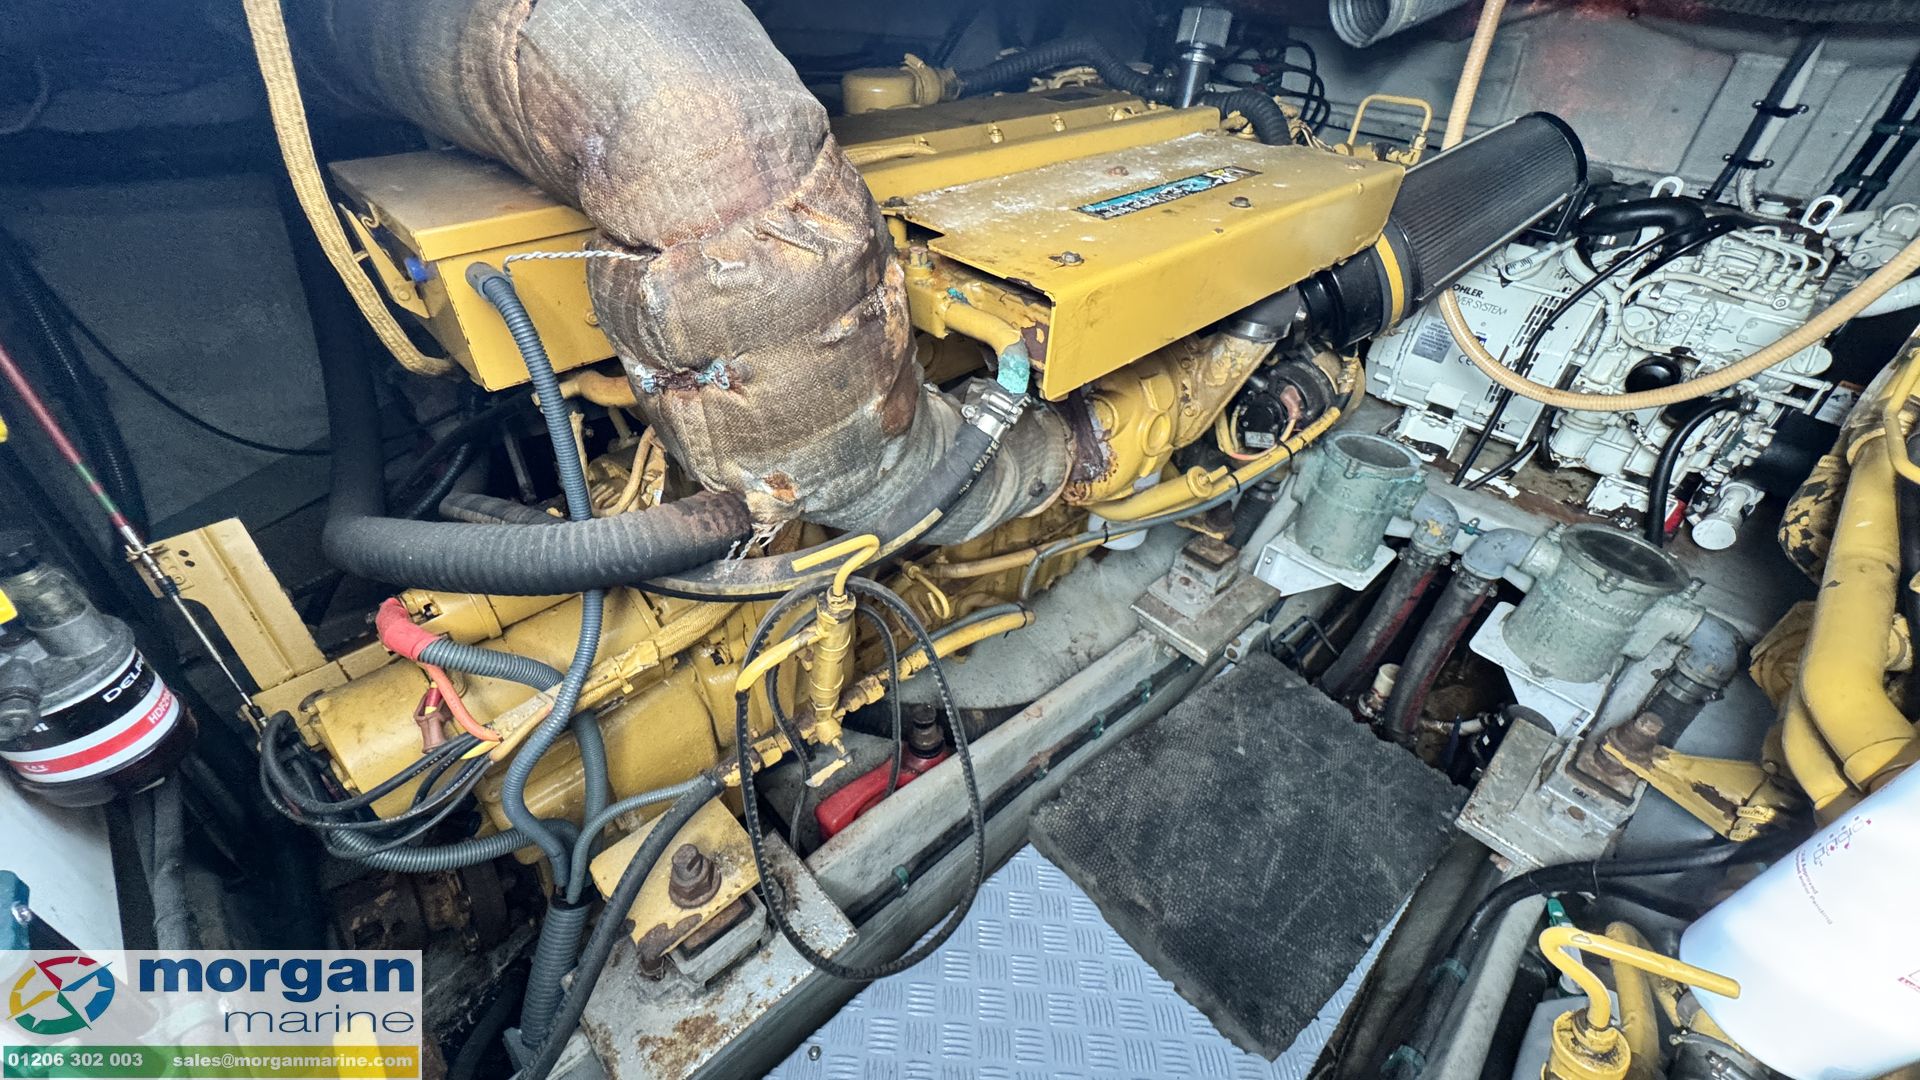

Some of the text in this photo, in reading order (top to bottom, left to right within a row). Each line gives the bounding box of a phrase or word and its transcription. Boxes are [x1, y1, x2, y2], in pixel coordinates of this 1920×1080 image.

[1452, 283, 1484, 298] OHLER
[1473, 299, 1508, 315] SYSTEM
[973, 440, 1000, 472] WATE
[102, 656, 144, 703] DELP
